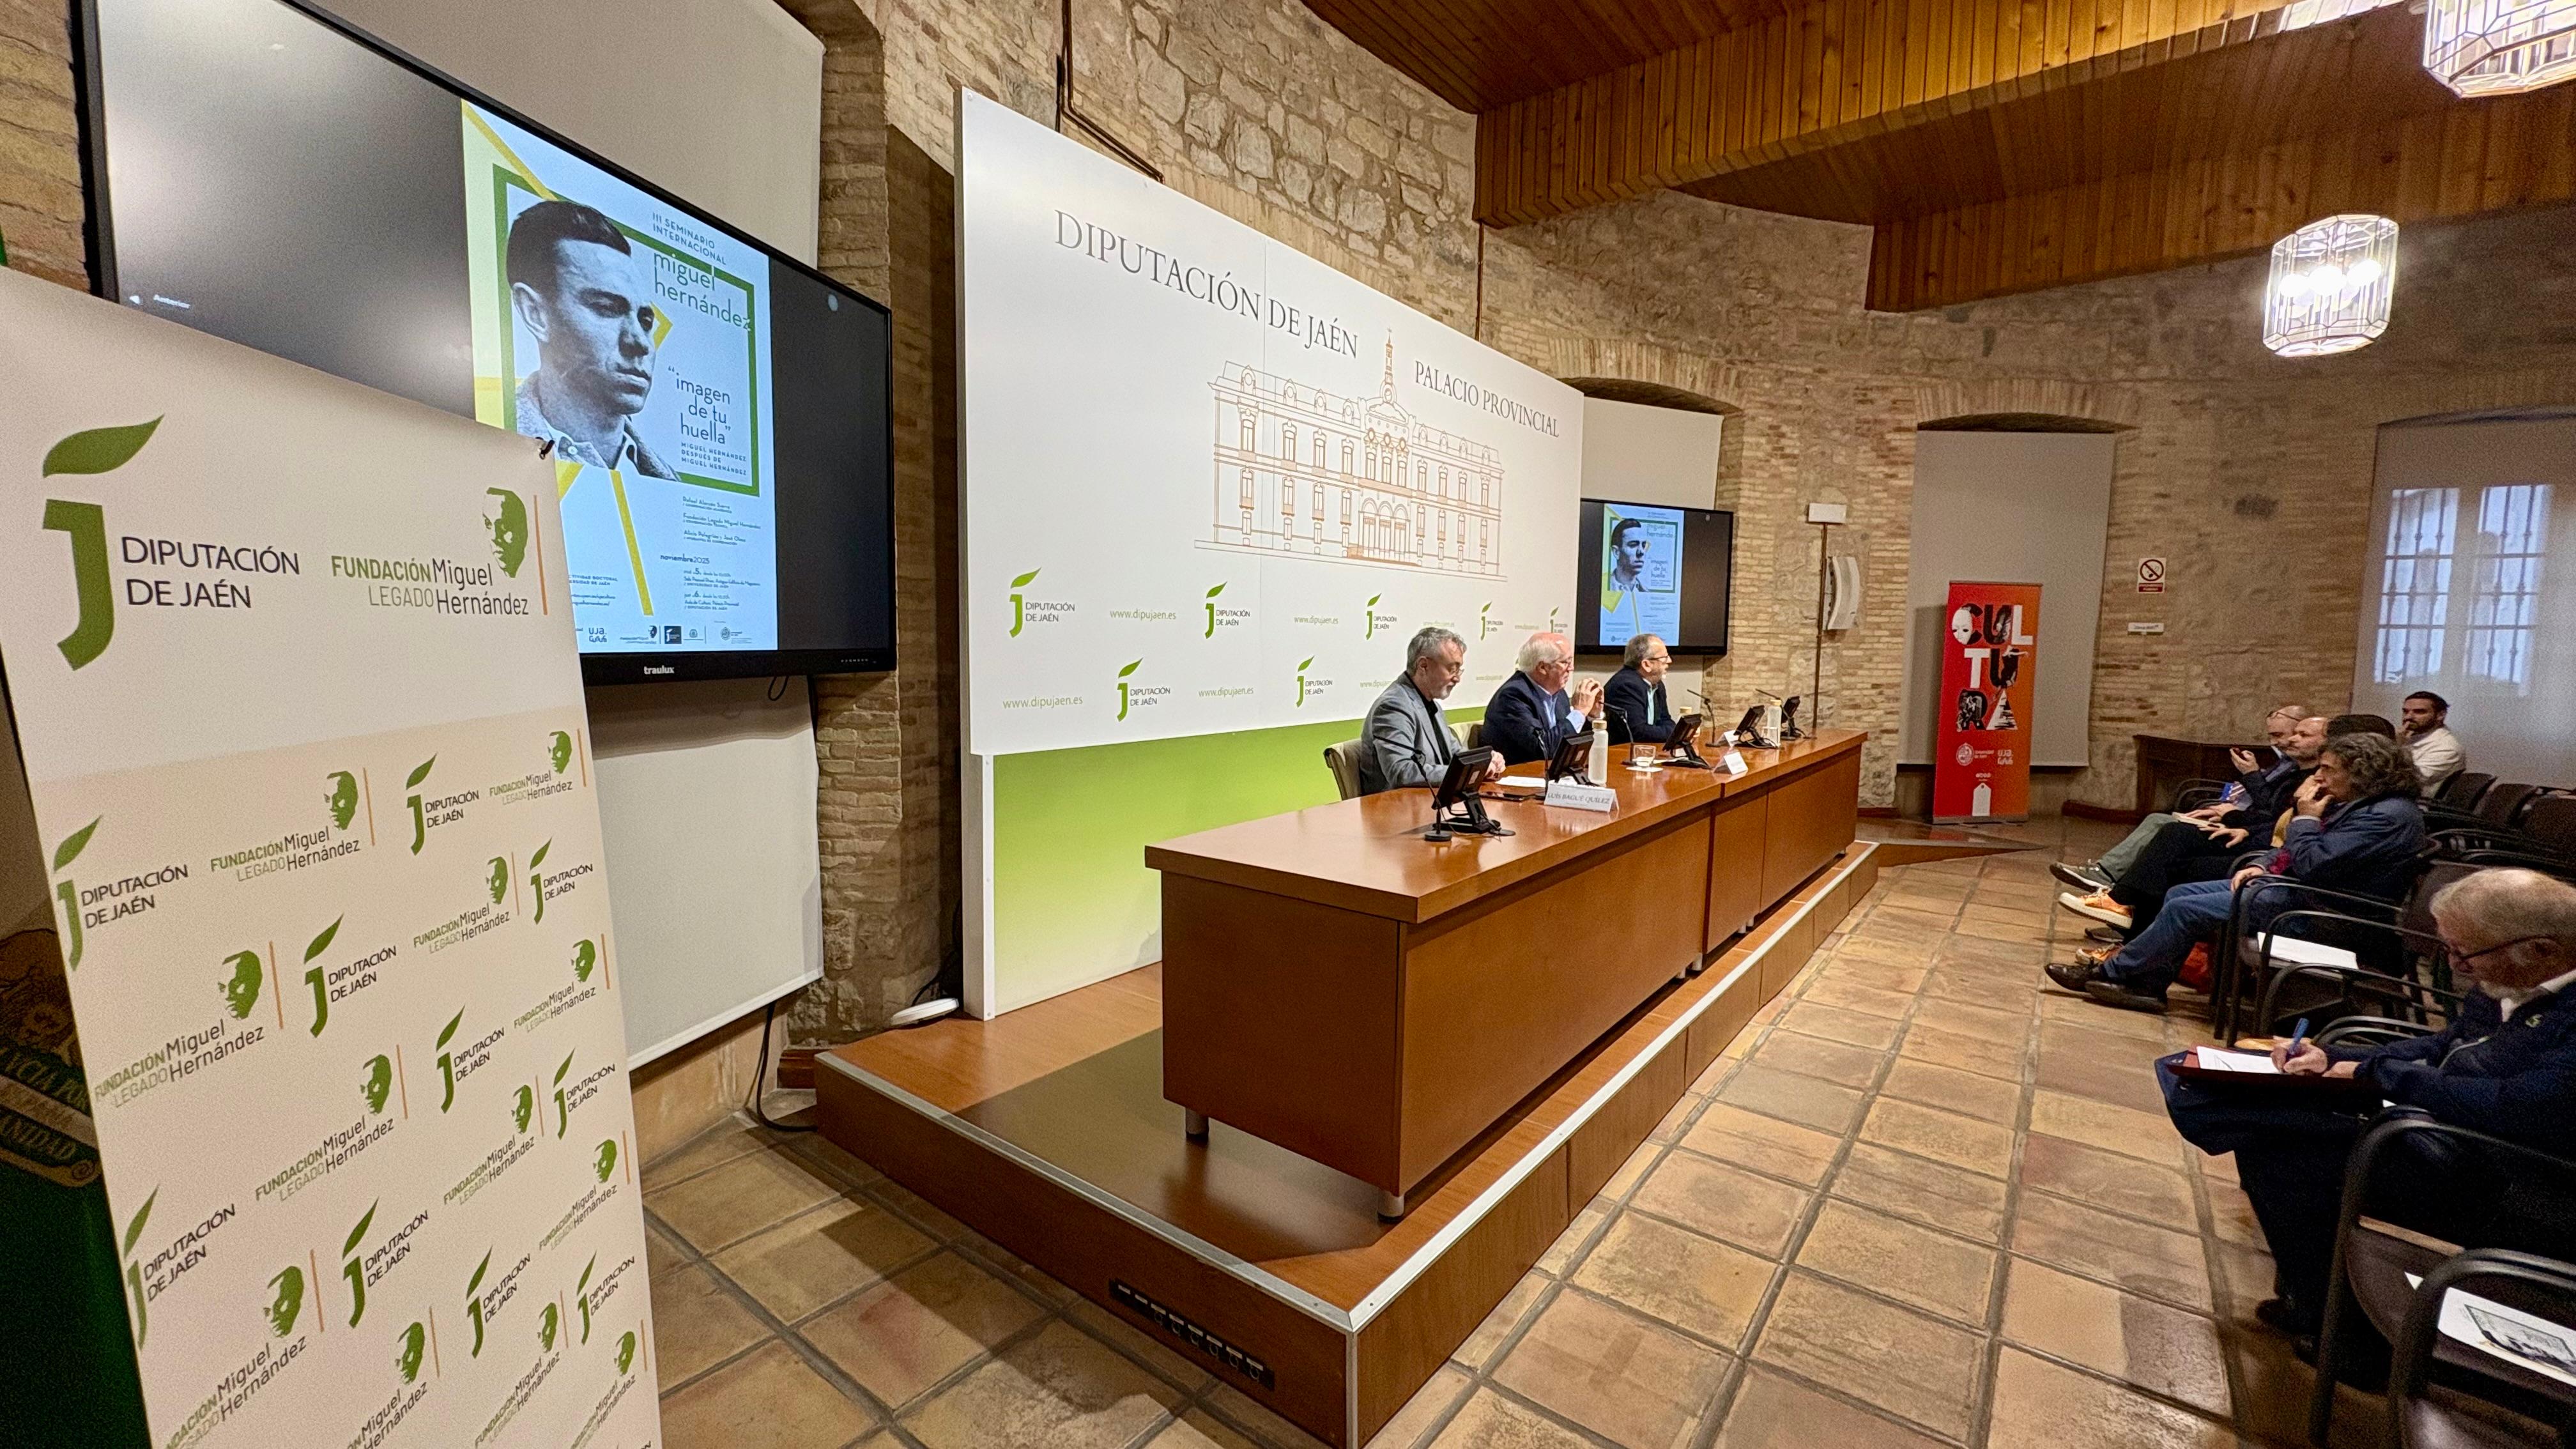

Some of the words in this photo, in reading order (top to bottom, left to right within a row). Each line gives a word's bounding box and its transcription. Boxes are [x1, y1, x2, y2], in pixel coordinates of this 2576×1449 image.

[653, 212, 661, 224] III
[665, 218, 715, 249] SEMINARIO
[653, 224, 726, 265] INTERNACIONAL
[654, 252, 715, 291] miguel
[1054, 210, 1261, 321] DIPUTACIÓN
[1268, 298, 1301, 337] DE
[1304, 315, 1358, 359] JAÉN
[654, 266, 752, 332] hernández
[688, 394, 708, 418] de
[712, 405, 726, 424] tu
[1415, 360, 1479, 406] PALACIO
[1483, 389, 1560, 438] PROVINCIAL
[681, 441, 707, 452] MIGUEL
[681, 457, 707, 467] MIGUEL
[121, 536, 300, 576] DIPUTACIÓN
[331, 555, 431, 583] FUNDACIÓN
[433, 557, 493, 590] Miguel
[126, 578, 172, 607] DE
[179, 578, 252, 609] JAÉN
[367, 585, 434, 608] LEGADO
[436, 589, 530, 616] Hernández
[1025, 601, 1075, 611] DIPUTACIÓN
[1025, 613, 1037, 622] DE
[1038, 612, 1059, 622] JAÉN
[1110, 608, 1176, 620] www.dipujaen.es
[1216, 609, 1250, 617] DIPUTACIÓN
[1225, 618, 1239, 626] JAÉN
[1951, 603, 2034, 646] CUL
[643, 665, 675, 675] traulux
[1003, 696, 1083, 709] www.dipujaen.es
[1130, 687, 1170, 696] DIPUTACIÓN
[1140, 697, 1157, 706] JAÉN
[1199, 687, 1254, 698] www.dipujaen.es
[526, 770, 552, 789] Miguel
[527, 780, 573, 801] Hernández
[425, 790, 479, 813] DIPUTACIÓN
[427, 817, 440, 828] DE
[441, 809, 464, 825] JAÉN
[210, 840, 284, 872] FUNDACIÓN
[284, 827, 330, 853] Miguel
[236, 856, 286, 882] LEGADO
[286, 839, 360, 871] Hernández
[81, 864, 189, 907] DIPUTACIÓN
[543, 863, 594, 887] DIPUTACIÓN
[544, 889, 556, 901] DE
[557, 881, 576, 898] JAÉN
[85, 909, 107, 929] DE
[110, 894, 155, 922] JAÉN
[459, 903, 490, 928] Miguel
[460, 911, 510, 942] Hernández
[328, 946, 397, 985] DIPUTACIÓN
[330, 988, 348, 1003] DE
[348, 972, 378, 997] JAÉN
[549, 982, 575, 1008] Miguel
[550, 986, 596, 1019] Hernández
[165, 1018, 225, 1061] Miguel
[169, 1026, 264, 1082] Hernández
[454, 1027, 505, 1068] DIPUTACIÓN
[456, 1068, 468, 1082] DE
[469, 1051, 491, 1078] JAÉN
[566, 1064, 616, 1100] DIPUTACIÓN
[567, 1100, 580, 1113] DE
[579, 1085, 598, 1108] JAÉN
[256, 1149, 323, 1201] FUNDACIÓN
[323, 1116, 366, 1156] Miguel
[279, 1163, 325, 1202] LEGADO
[325, 1118, 394, 1174] Hernández
[487, 1134, 516, 1168] Miguel
[489, 1136, 535, 1182] Hernández
[574, 1184, 618, 1228] Hernández
[144, 1204, 236, 1280] DIPUTACIÓN
[365, 1210, 429, 1272] DIPUTACIÓN
[148, 1280, 167, 1302] DE
[167, 1245, 207, 1291] JAÉN
[367, 1269, 384, 1288] DE
[383, 1243, 411, 1278] JAÉN
[483, 1253, 531, 1310] DIPUTACIÓN
[590, 1255, 635, 1305] DIPUTACIÓN
[484, 1306, 498, 1323] DE
[496, 1283, 518, 1314] JAÉN
[217, 1342, 270, 1402] Miguel
[220, 1336, 307, 1422] Hernández
[517, 1351, 560, 1411] Hernández
[361, 1388, 401, 1441] Miguel
